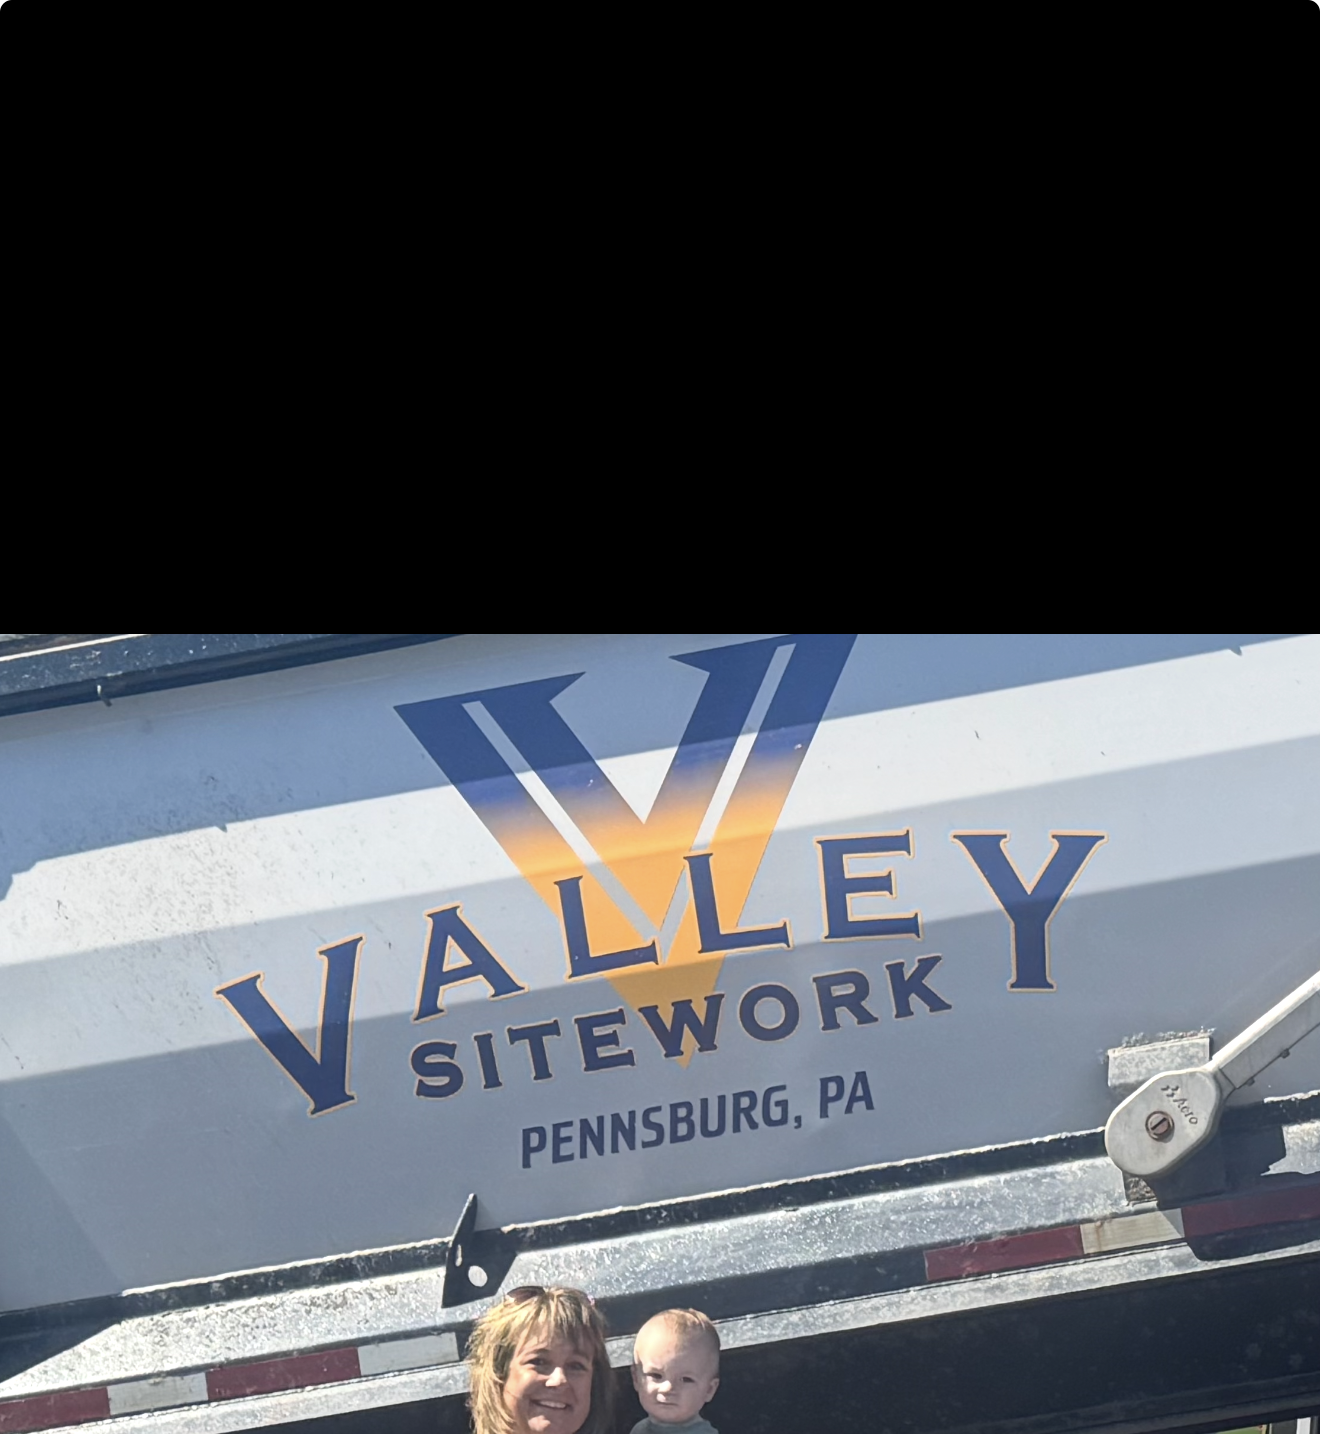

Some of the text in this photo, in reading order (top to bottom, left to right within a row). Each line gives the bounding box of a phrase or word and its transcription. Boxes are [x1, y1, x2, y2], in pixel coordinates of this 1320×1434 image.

[214, 828, 1108, 1117] VALLEY
[409, 954, 952, 1099] SITEWORK
[521, 1071, 875, 1169] PENNSBURG, PA
[1173, 1099, 1198, 1125] Aero
